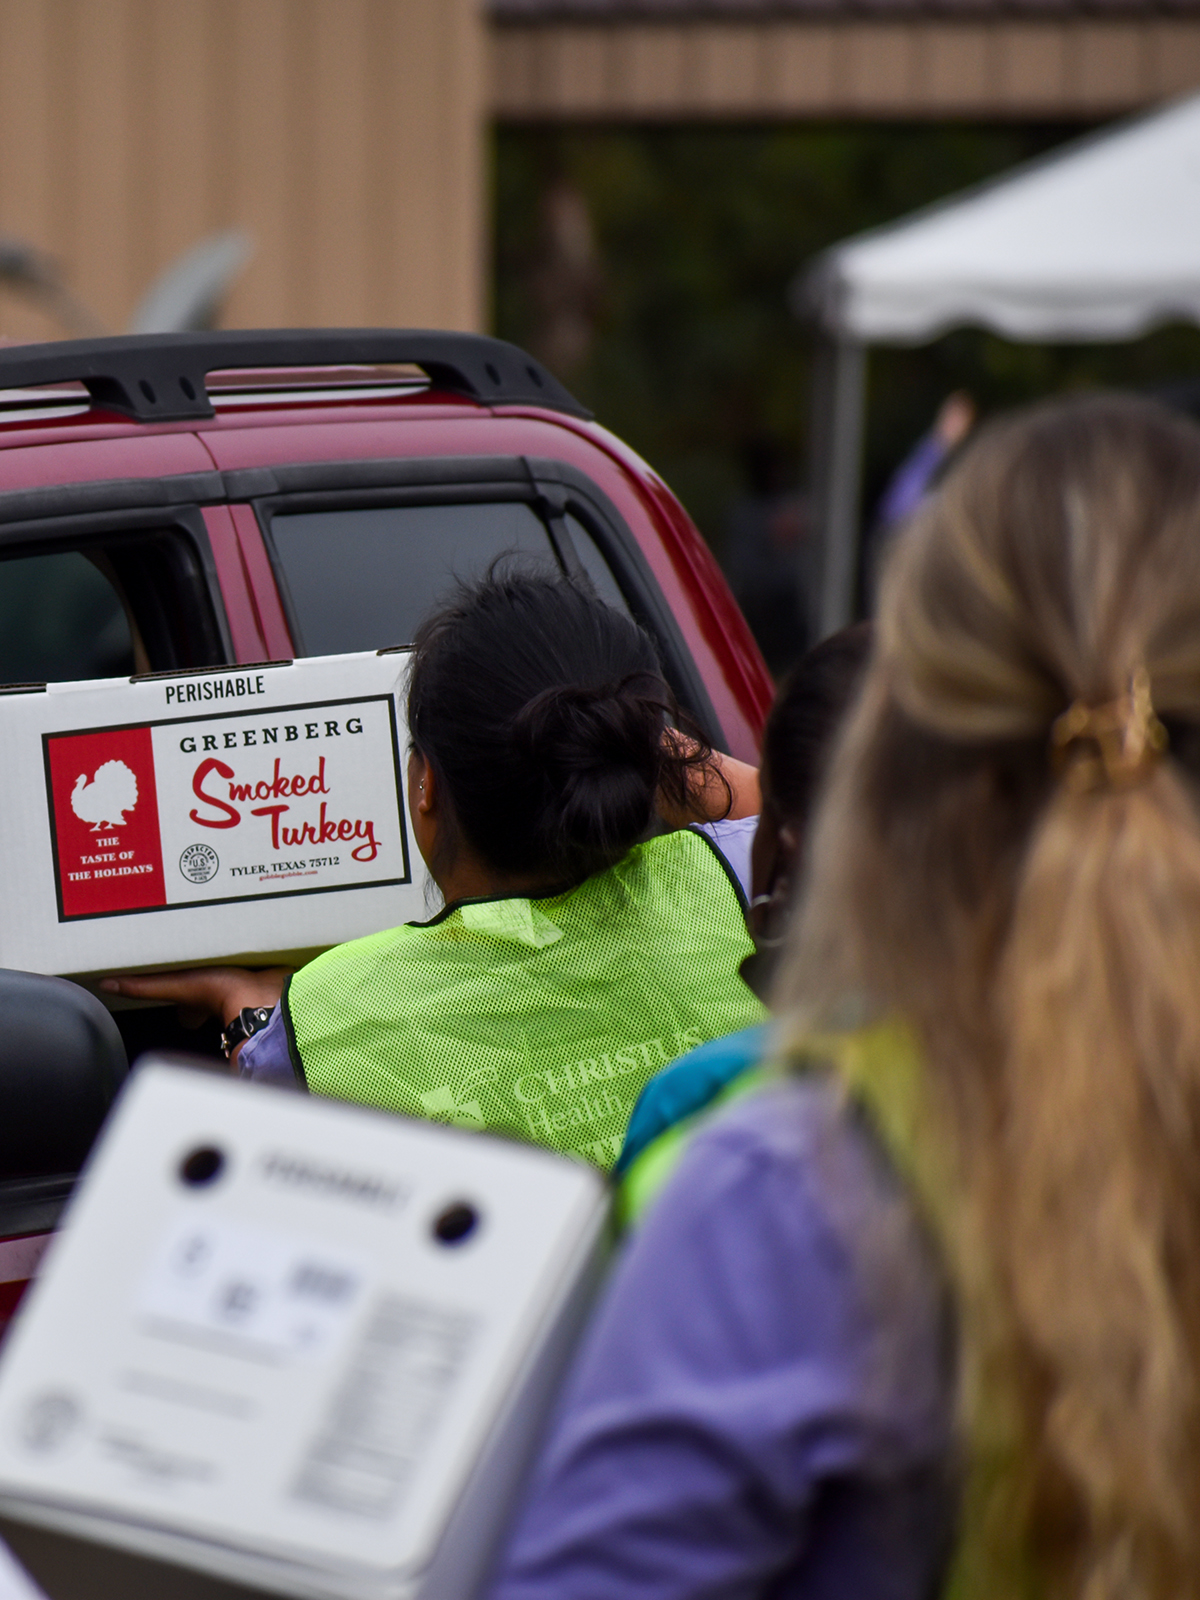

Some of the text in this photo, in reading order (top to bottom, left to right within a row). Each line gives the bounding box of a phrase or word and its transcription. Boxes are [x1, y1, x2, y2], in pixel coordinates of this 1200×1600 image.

[165, 675, 266, 705] PERISHABLE
[179, 717, 364, 754] GREENBERG
[189, 755, 331, 830] Smoked
[96, 836, 120, 847] THE
[250, 801, 383, 863] Turkey
[80, 850, 135, 865] TASTE OF
[183, 845, 215, 863] INSPECTED
[229, 856, 341, 877] TYLER, TEXAS 75712
[67, 863, 154, 882] THE HOLIDAYS
[514, 1026, 705, 1103] CHRISTUS
[526, 1090, 623, 1140] Health
